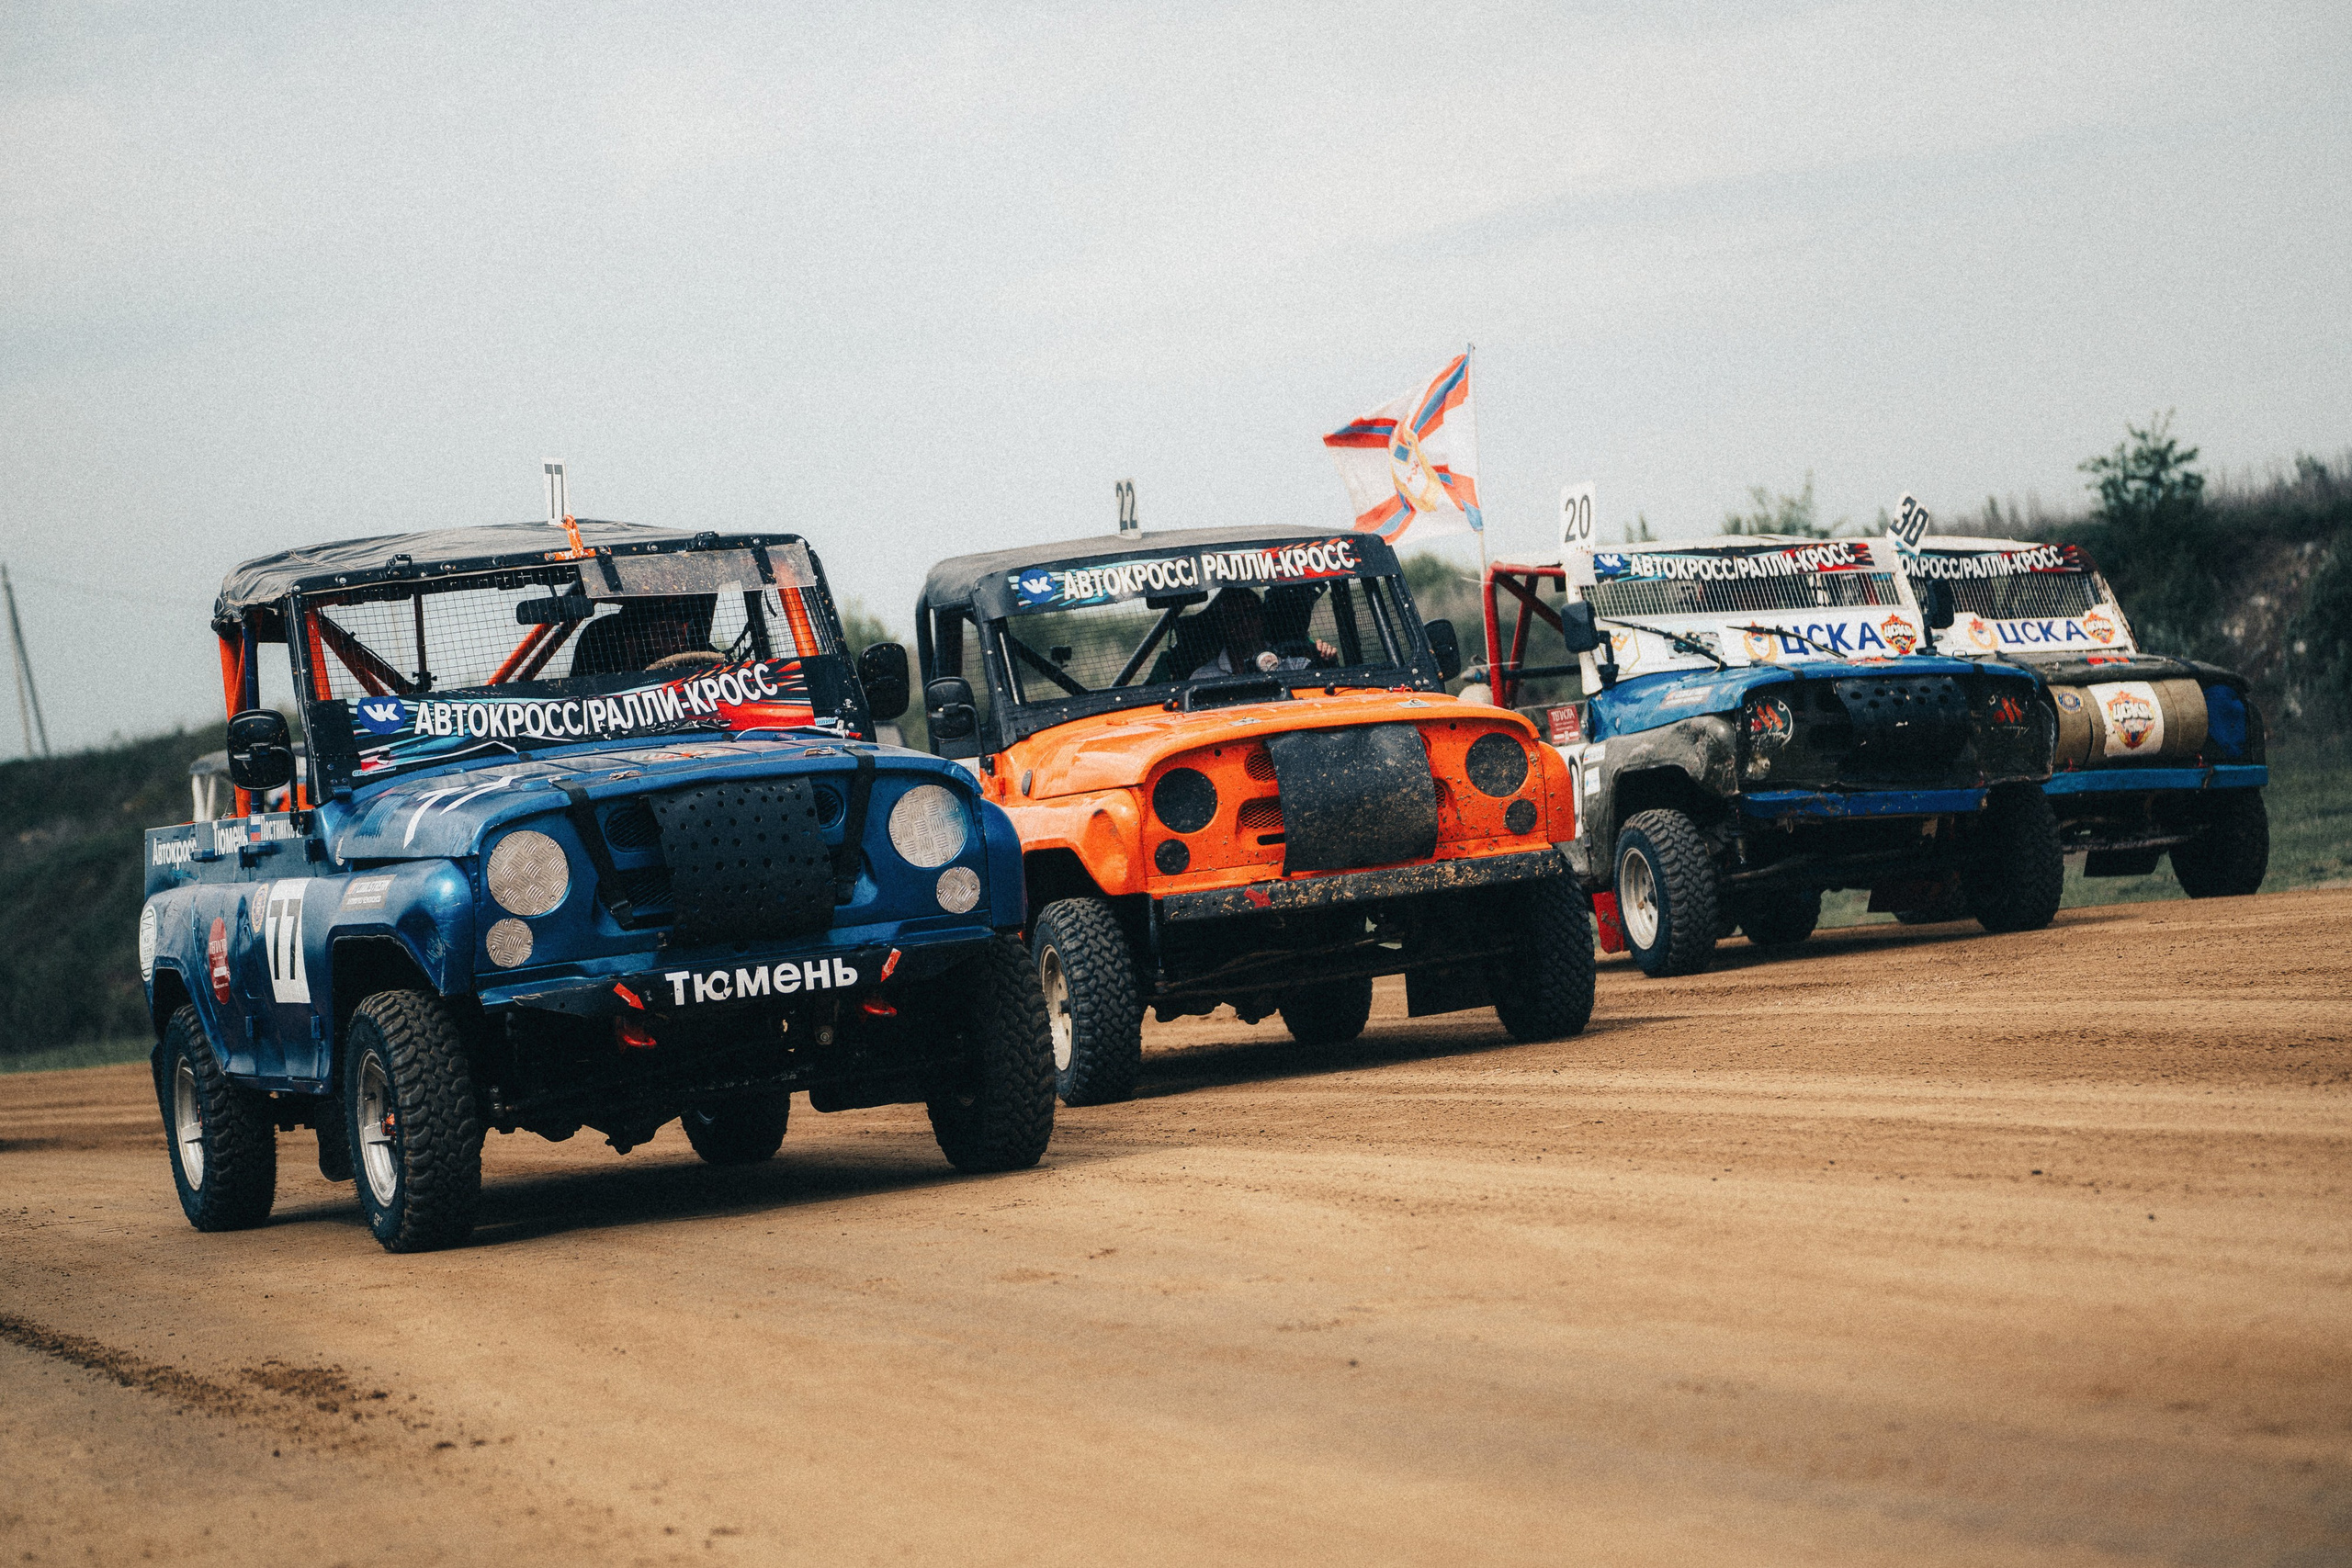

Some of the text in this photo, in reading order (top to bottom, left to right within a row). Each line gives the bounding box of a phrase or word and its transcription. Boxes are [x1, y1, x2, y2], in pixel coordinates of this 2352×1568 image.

[545, 463, 565, 520] 77
[1115, 481, 1138, 532] 22
[1564, 494, 1591, 543] 20
[1889, 496, 1929, 547] 30
[1780, 622, 1886, 655] ЦСКА
[1996, 619, 2088, 644] ЦСКА
[212, 820, 249, 856] Тюмень
[269, 898, 301, 981] 77
